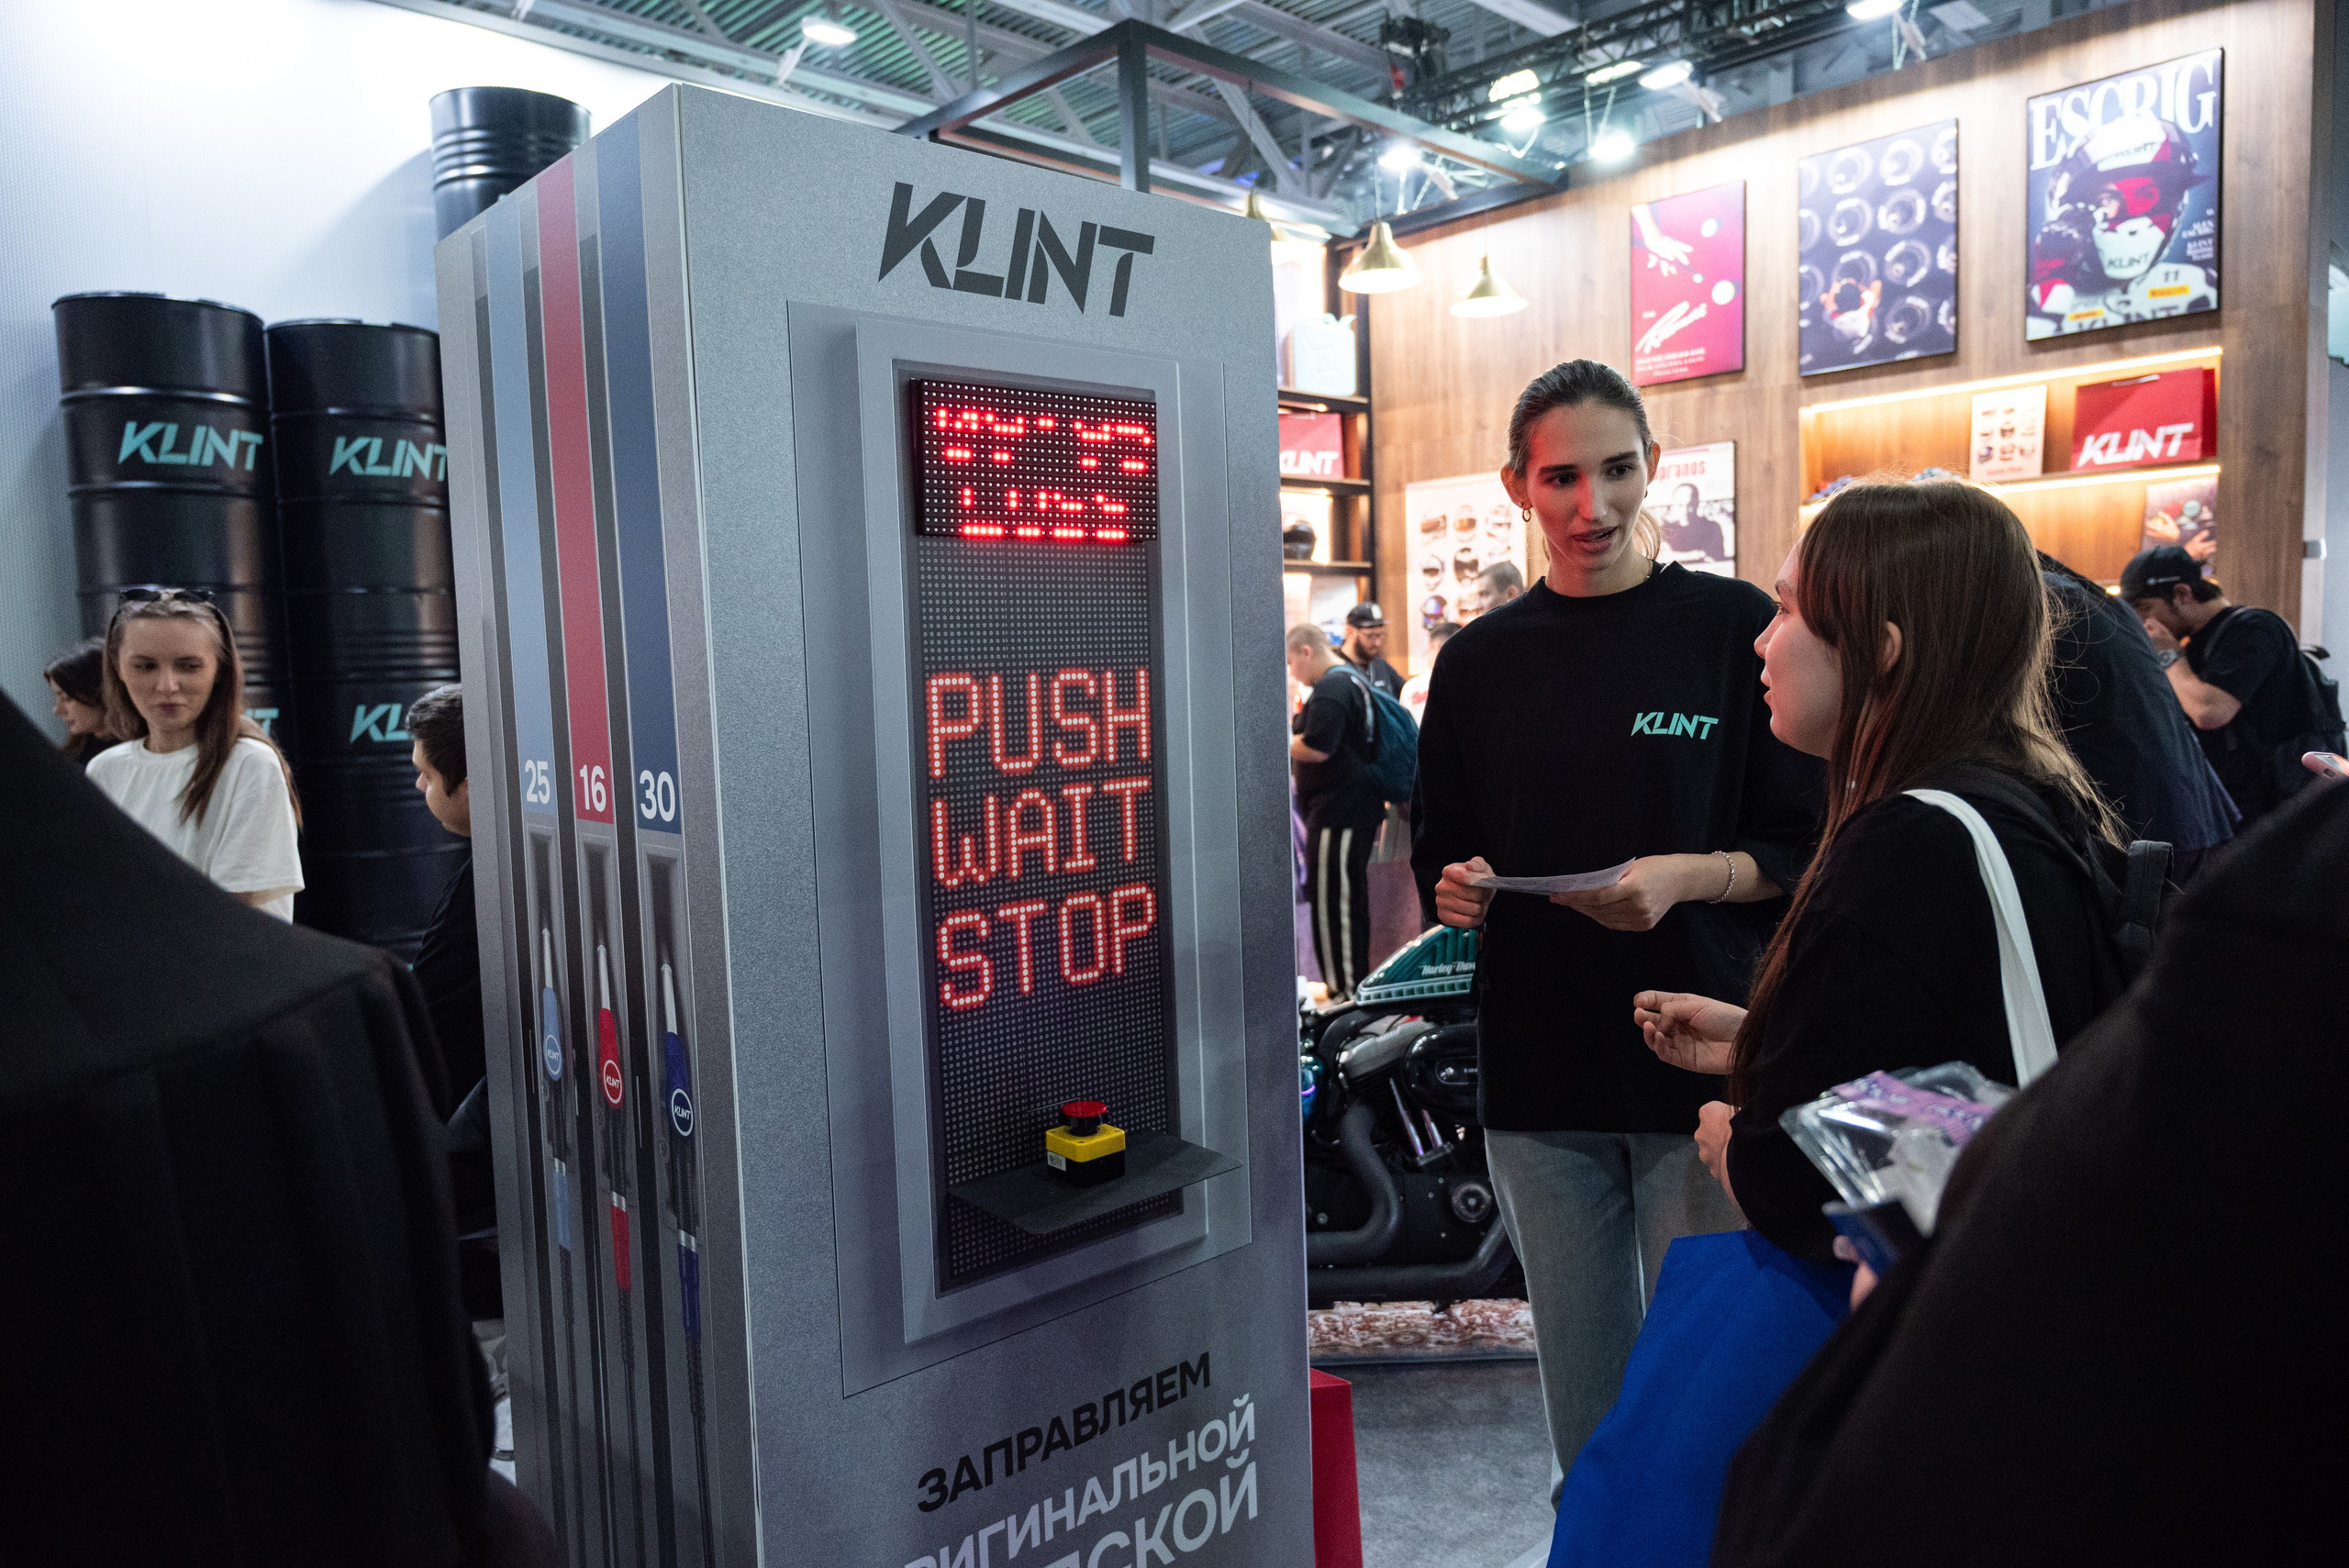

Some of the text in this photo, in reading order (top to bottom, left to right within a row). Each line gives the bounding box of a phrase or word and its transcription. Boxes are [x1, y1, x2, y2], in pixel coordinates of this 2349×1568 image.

[2029, 58, 2217, 171] ESCRIG
[878, 182, 1155, 317] KLINT
[117, 421, 264, 472] KLINT
[329, 436, 447, 482] KLINT
[2076, 422, 2194, 467] KLINT
[1655, 461, 1705, 483] pranos
[928, 667, 1150, 778] PUSH
[1631, 712, 1719, 740] KLINT
[524, 760, 551, 805] 25
[579, 764, 607, 813] 16
[640, 770, 676, 822] 30
[931, 776, 1152, 889] WAIT
[937, 883, 1156, 1009] STOP
[606, 1075, 620, 1089] KLINT
[674, 1105, 691, 1120] KLINT
[918, 1351, 1210, 1513] ЗАПРАВЛЯЕМ
[905, 1394, 1256, 1568] ИГИНАЛЬНОЙ
[1044, 1449, 1258, 1568] СКОЙ
